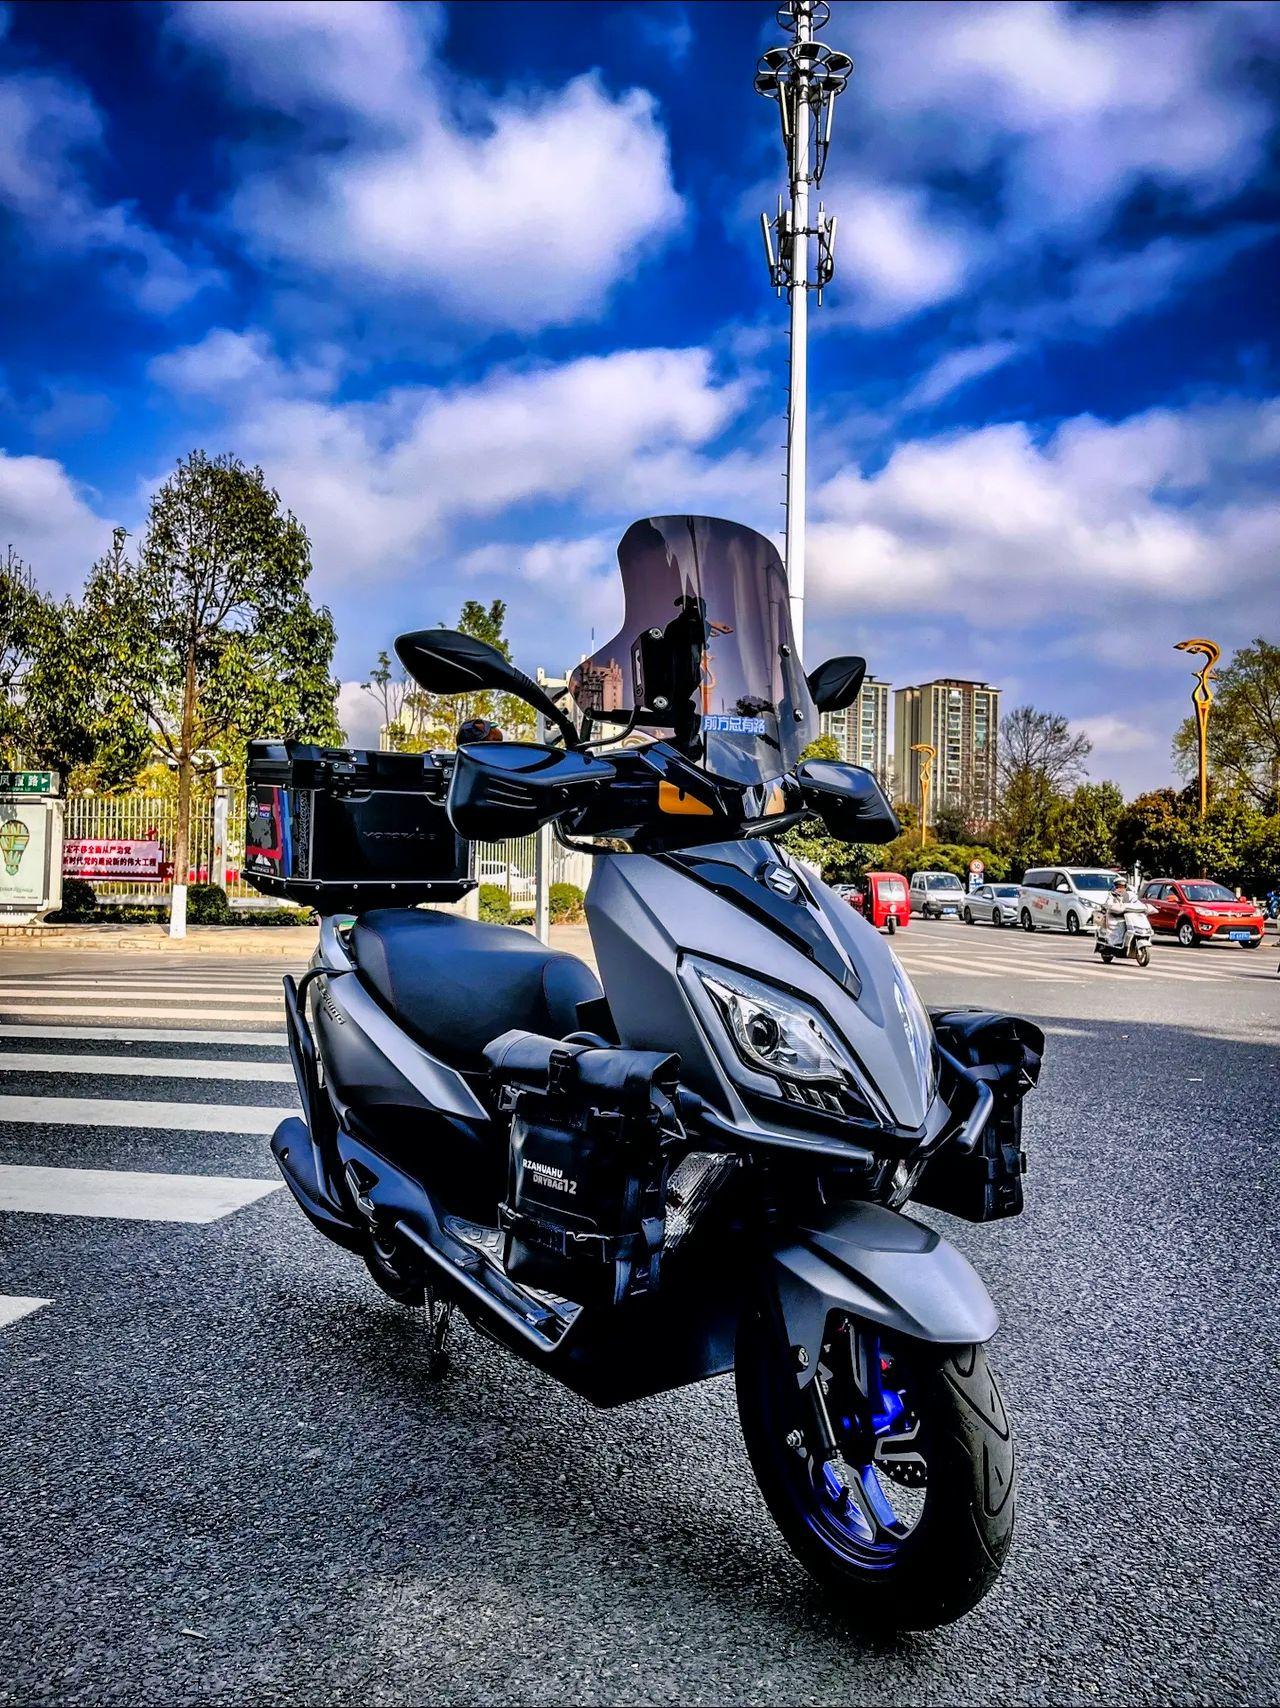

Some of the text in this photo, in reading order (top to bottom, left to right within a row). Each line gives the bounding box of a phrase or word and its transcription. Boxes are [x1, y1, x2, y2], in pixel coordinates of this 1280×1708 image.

[703, 715, 766, 734] 前方总有路
[63, 845, 132, 855] 定不移全面从严治党
[522, 1158, 563, 1178] RZAHUAHU
